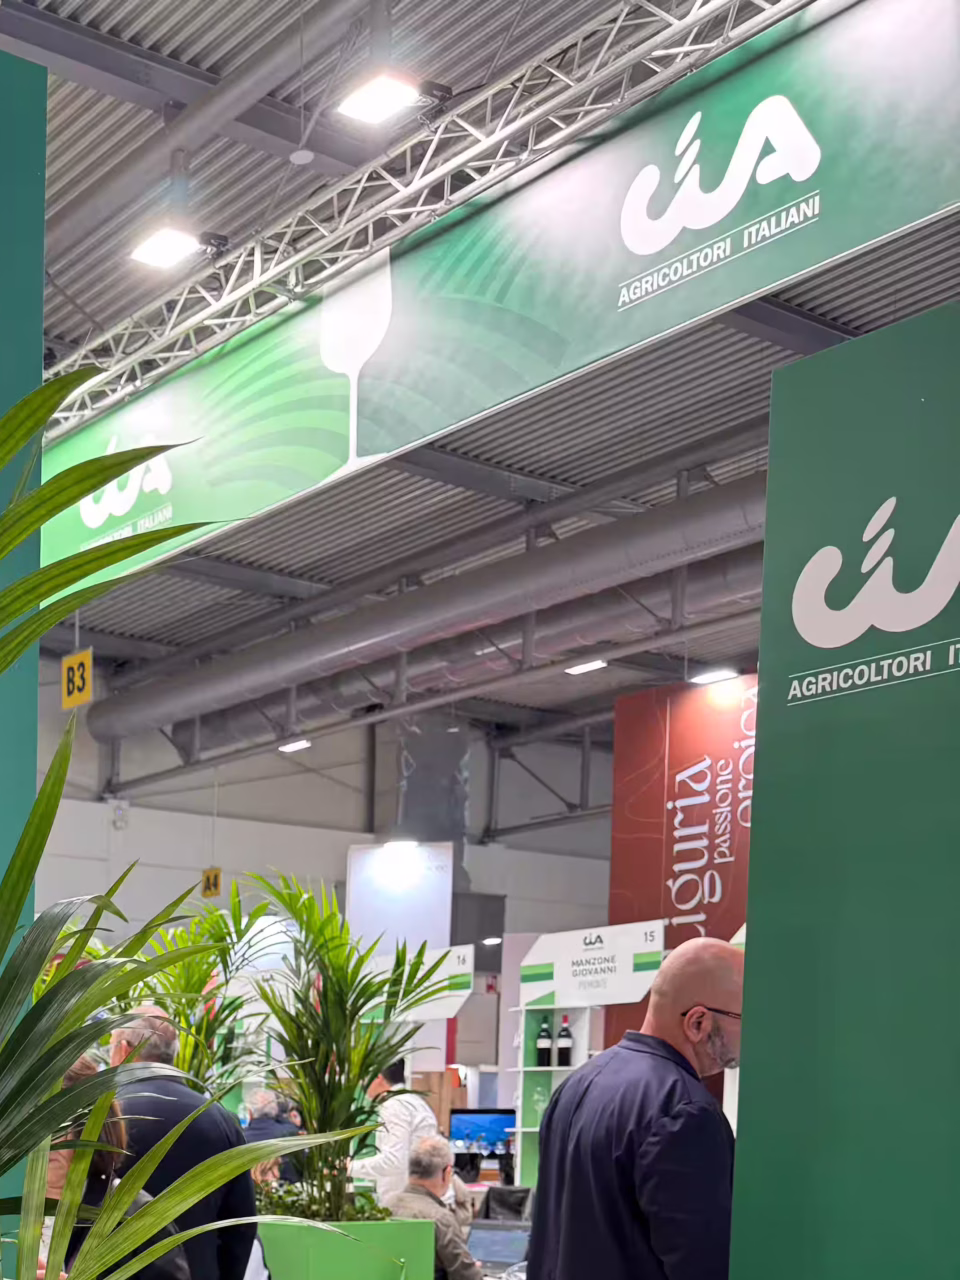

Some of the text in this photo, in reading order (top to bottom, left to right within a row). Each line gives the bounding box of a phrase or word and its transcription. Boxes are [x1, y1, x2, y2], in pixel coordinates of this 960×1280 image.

[617, 194, 820, 307] AGRICOLTORI ITALIANI
[66, 661, 86, 698] B3
[787, 650, 932, 700] AGRICOLTORI
[712, 757, 736, 864] passione
[666, 754, 723, 937] iguria
[203, 873, 219, 892] A4
[644, 930, 656, 943] 15
[456, 954, 467, 966] 16
[571, 954, 617, 968] MANZONE
[571, 965, 617, 978] GIOVANNI
